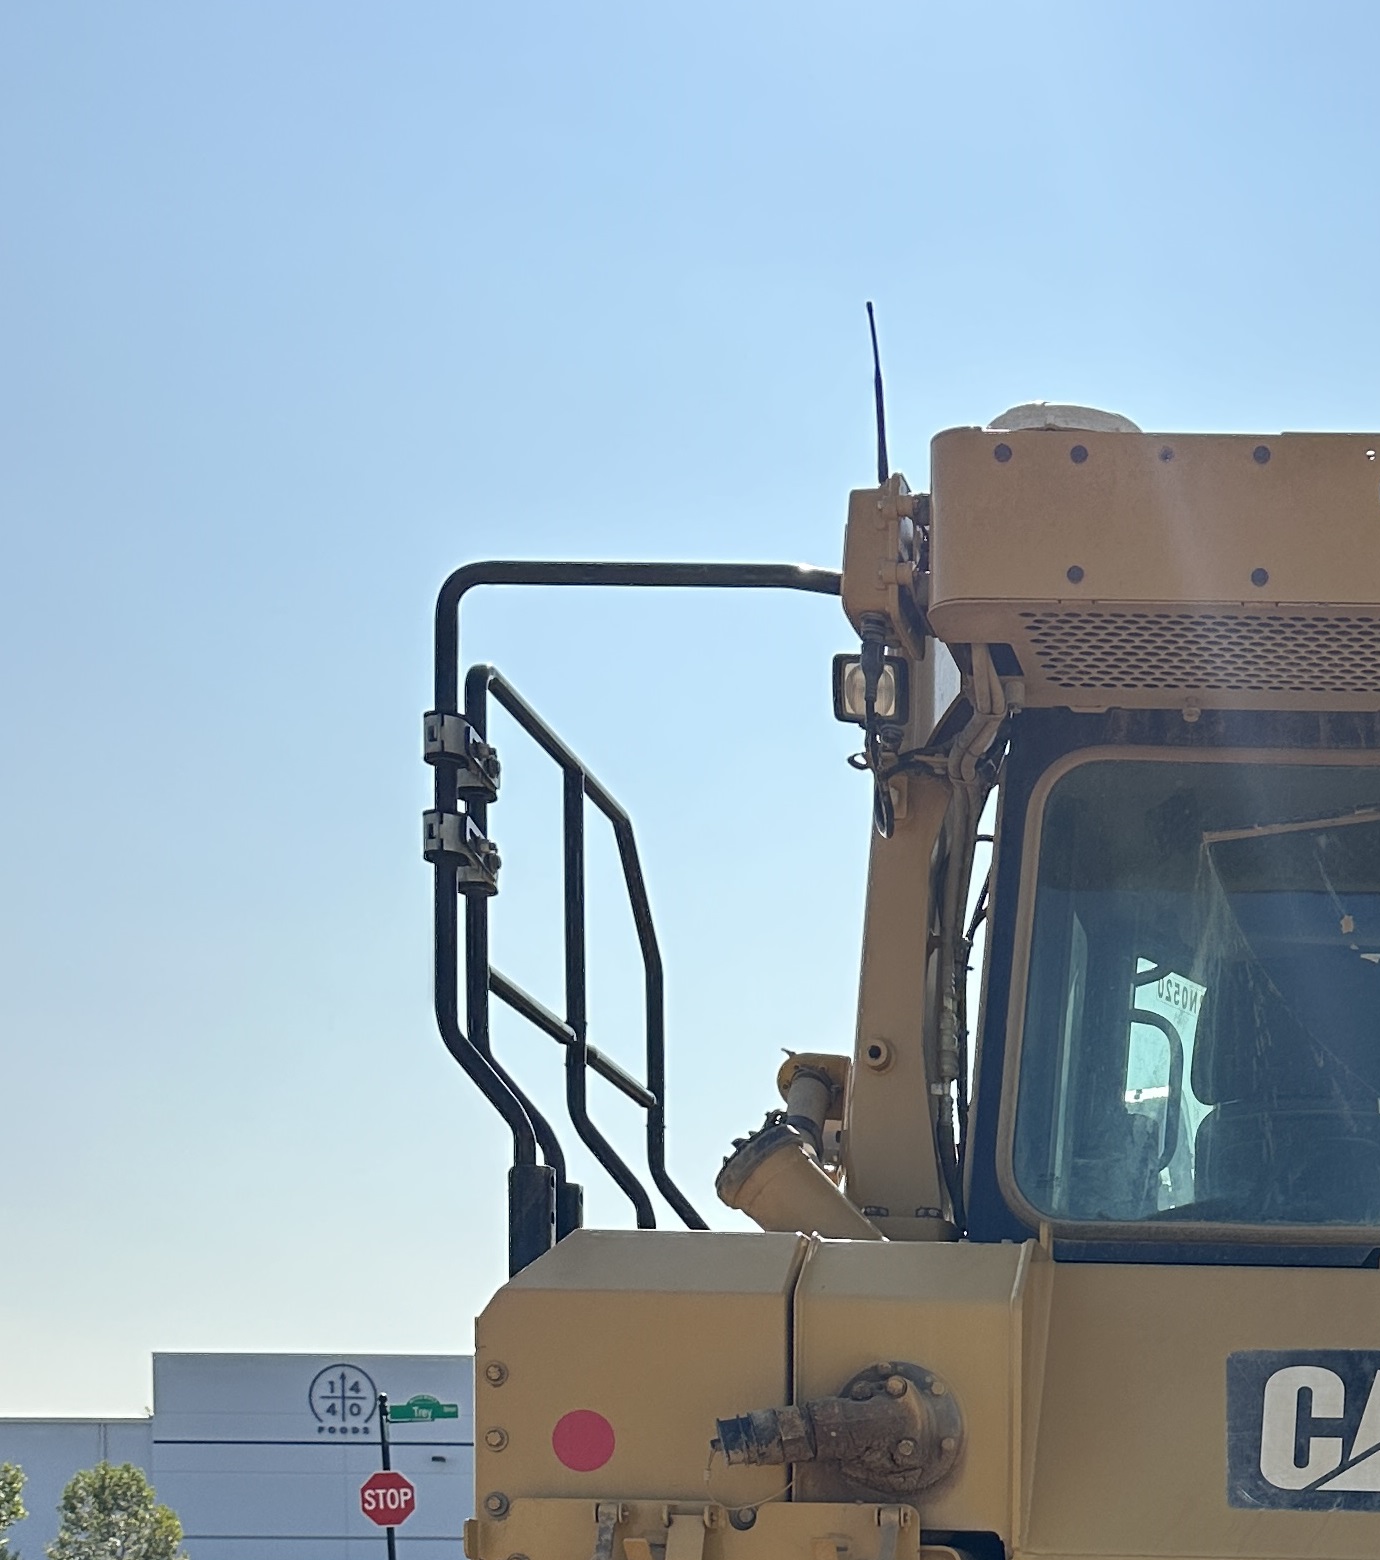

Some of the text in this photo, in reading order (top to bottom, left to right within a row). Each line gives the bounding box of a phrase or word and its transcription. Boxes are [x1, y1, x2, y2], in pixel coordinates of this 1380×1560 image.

[413, 1406, 433, 1419] Trey
[318, 1426, 370, 1434] FOODS
[364, 1488, 412, 1510] STOP
